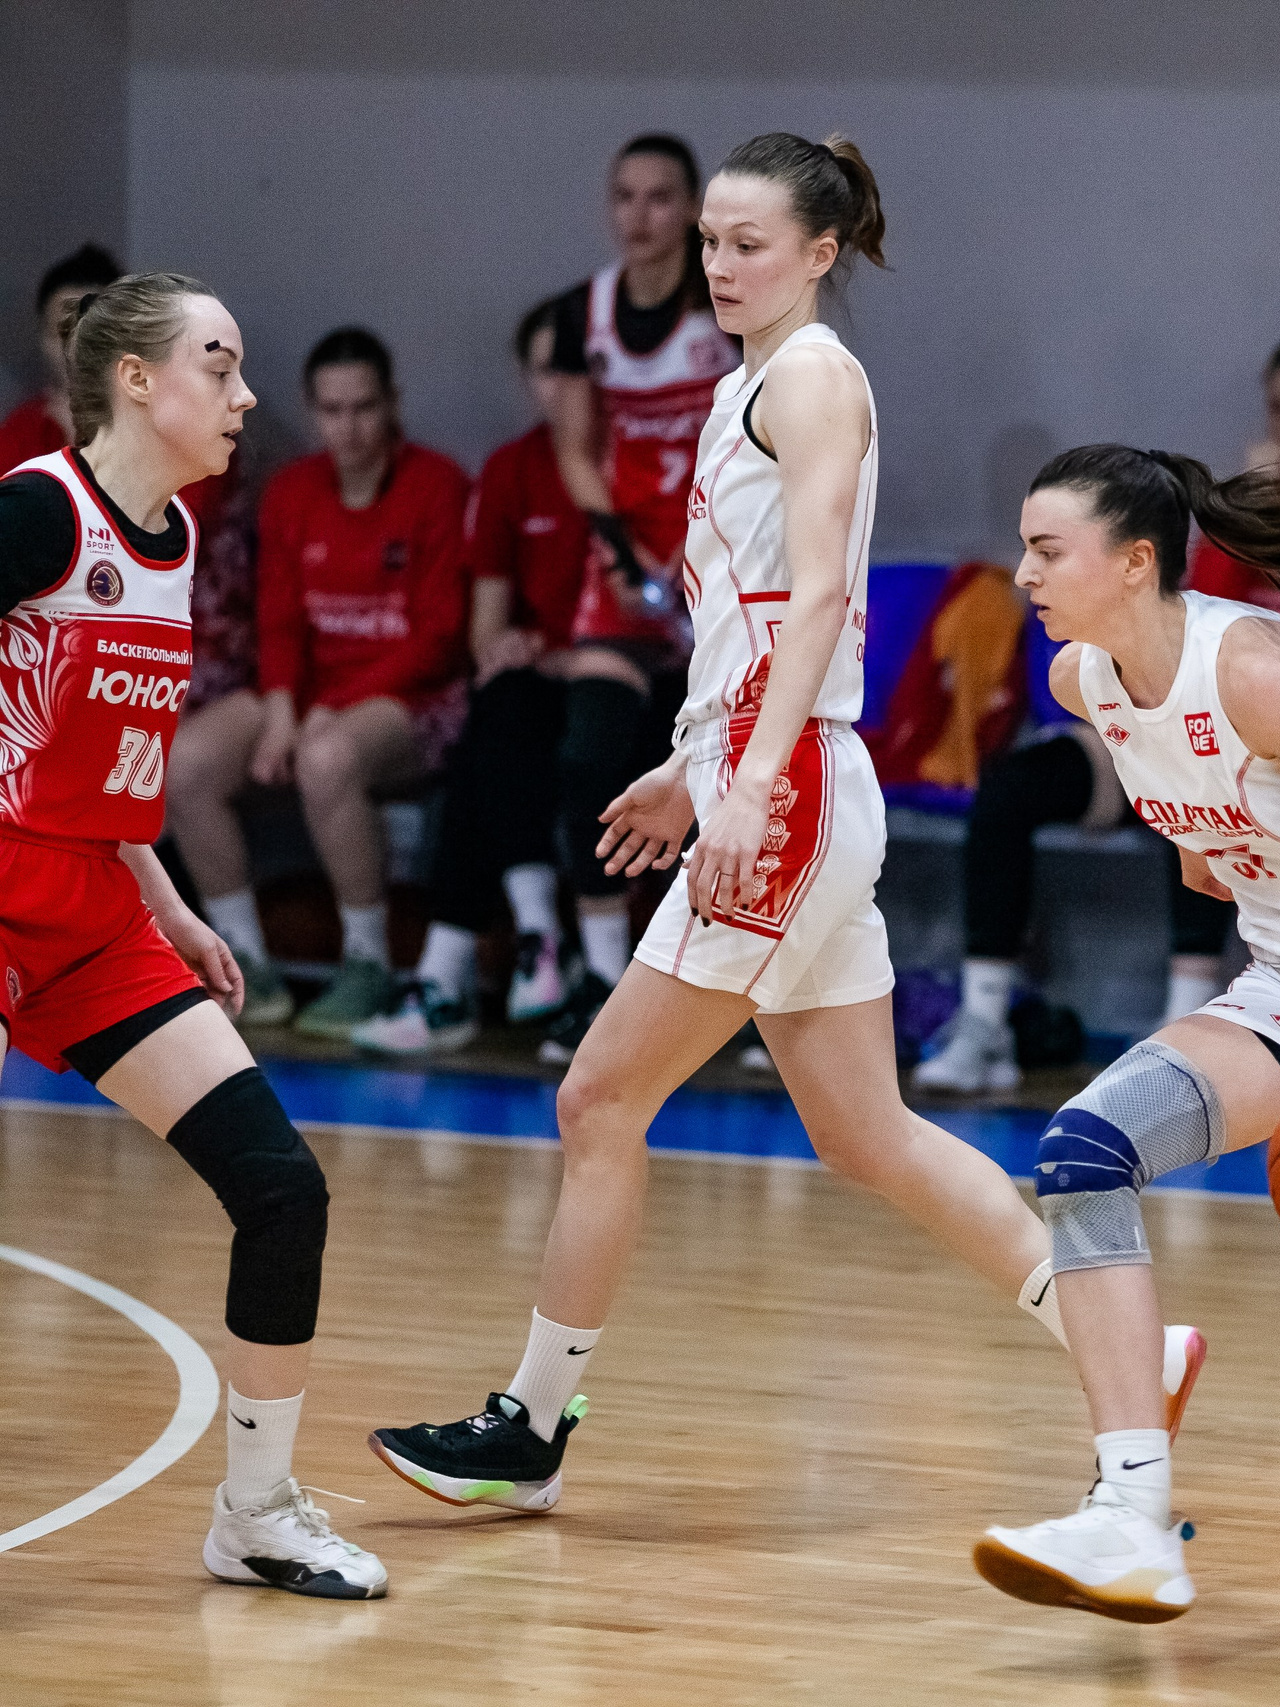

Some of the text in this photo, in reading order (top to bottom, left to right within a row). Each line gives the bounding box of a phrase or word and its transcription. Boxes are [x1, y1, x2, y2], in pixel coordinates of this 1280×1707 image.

[86, 541, 115, 551] SPORT
[97, 639, 189, 665] БАСКЕТБОЛЬНЫЙ
[87, 667, 190, 712] ЮНОС
[103, 726, 164, 800] 30
